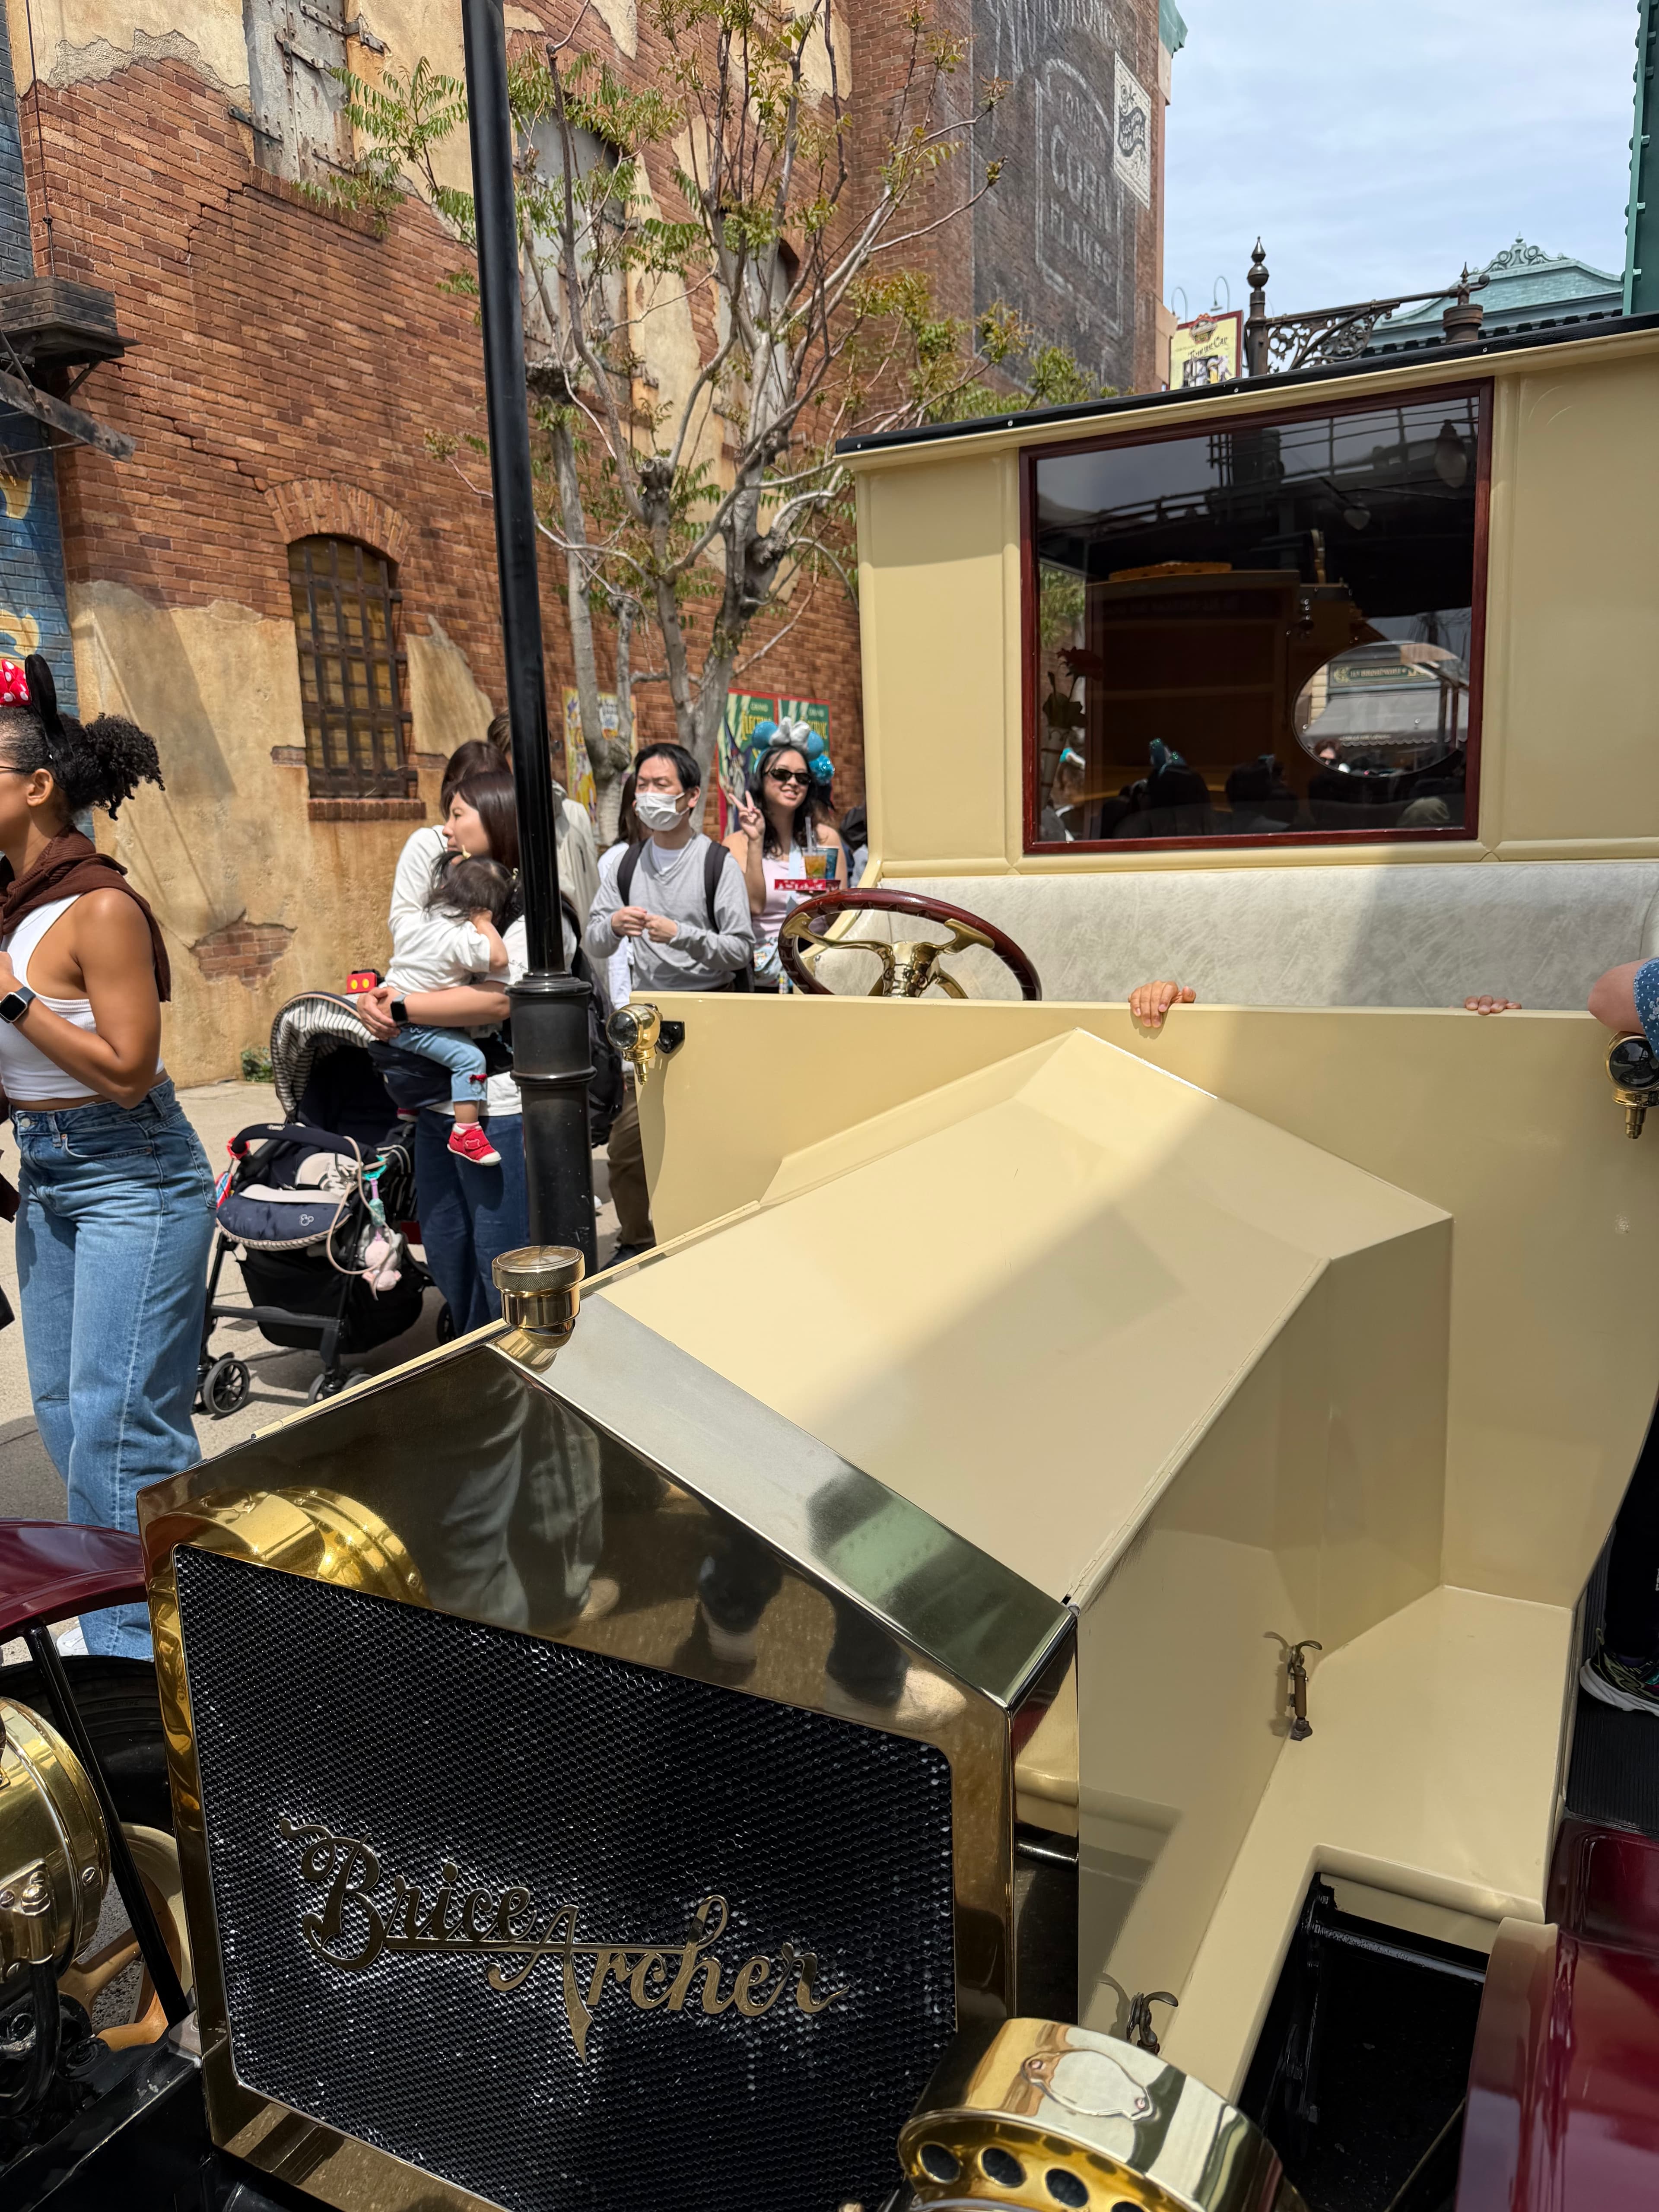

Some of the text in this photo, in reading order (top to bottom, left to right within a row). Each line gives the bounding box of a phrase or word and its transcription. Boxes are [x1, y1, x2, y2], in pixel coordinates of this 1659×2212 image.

[1050, 124, 1111, 233] CORN
[1050, 197, 1112, 287] FLAKES
[281, 1817, 538, 1970] Brice
[487, 1894, 849, 2065] Archer
